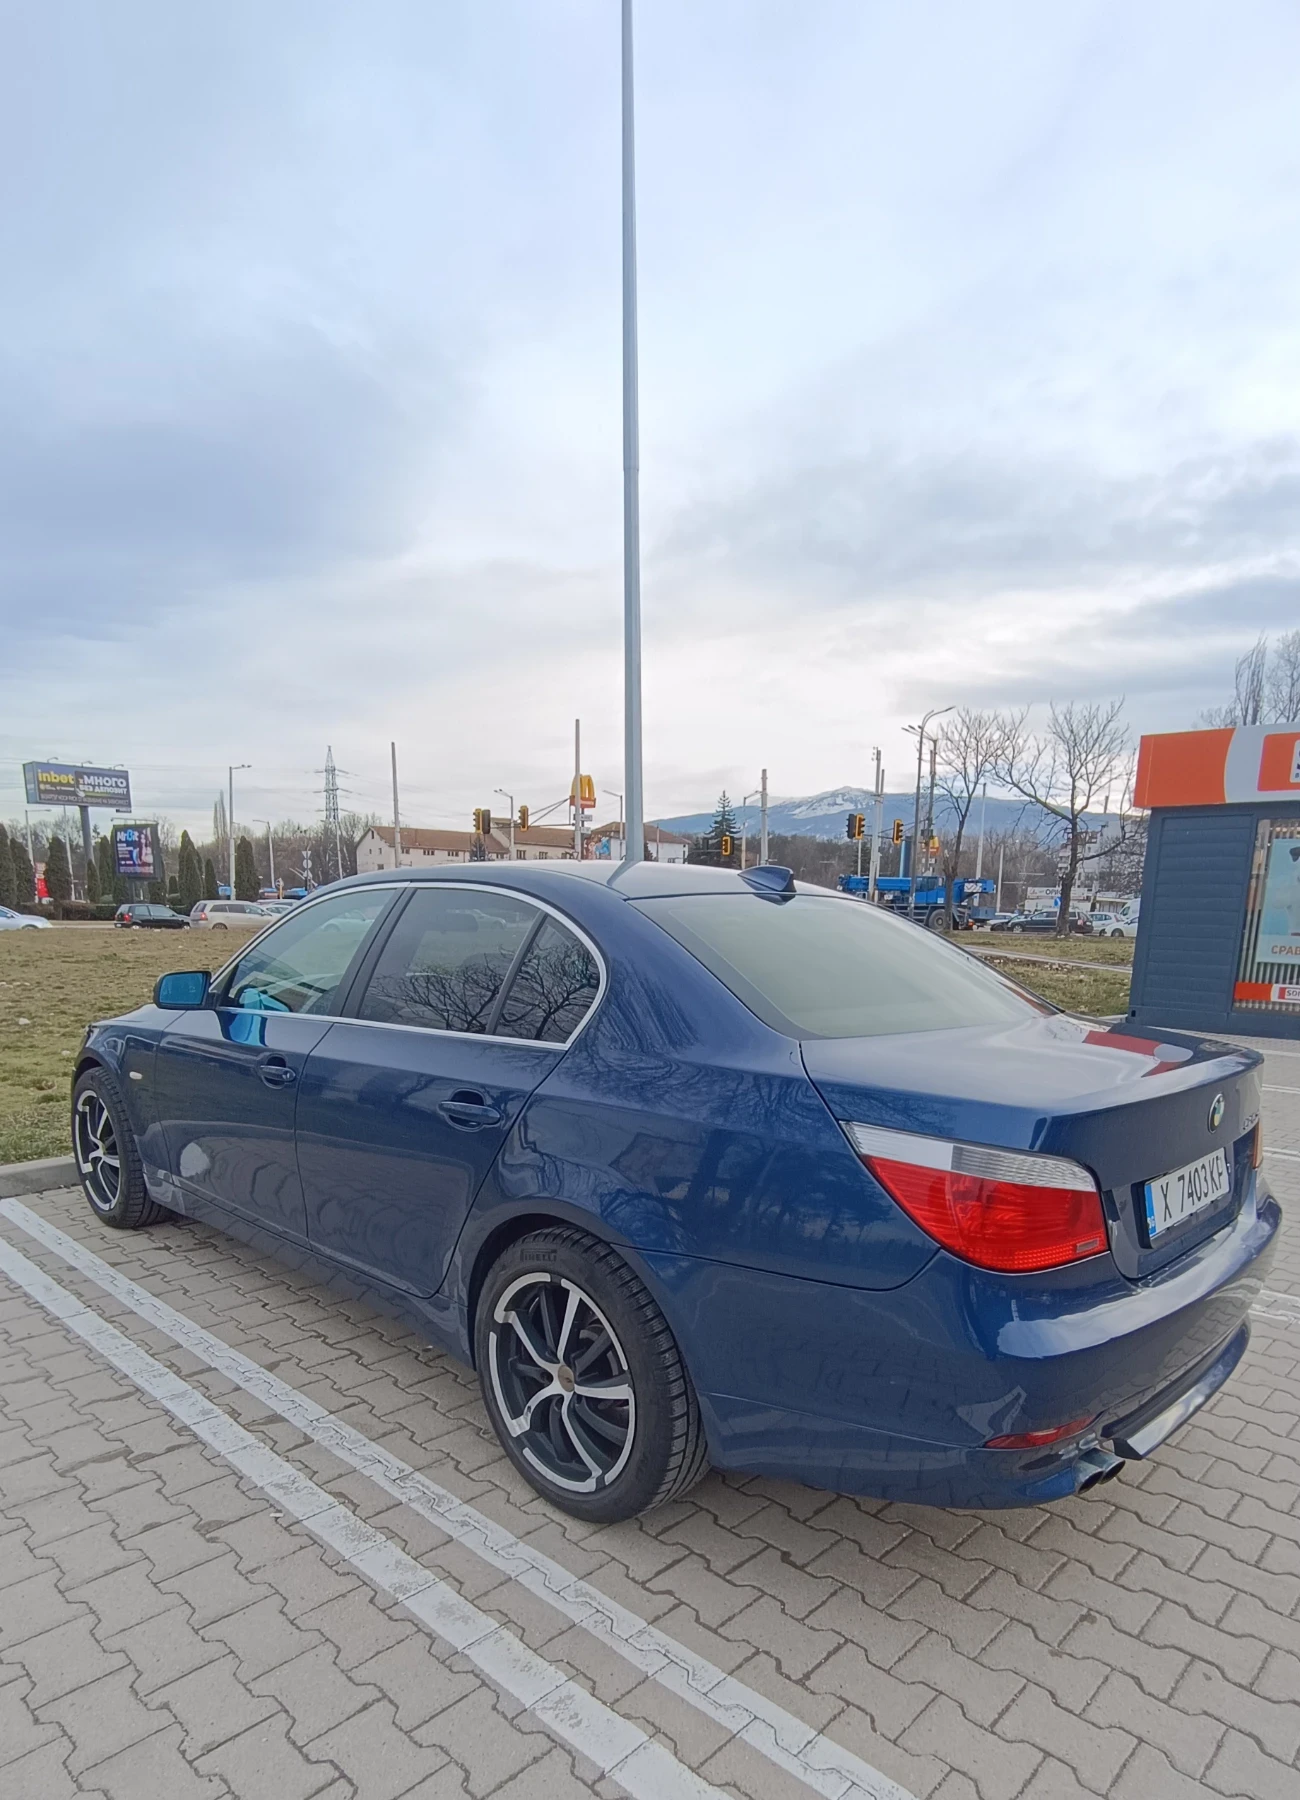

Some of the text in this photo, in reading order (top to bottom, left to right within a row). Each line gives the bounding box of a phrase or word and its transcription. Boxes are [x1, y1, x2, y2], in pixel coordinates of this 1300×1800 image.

[38, 769, 75, 784] inbet
[83, 774, 126, 788] МНОГО
[1160, 1181, 1172, 1222] X
